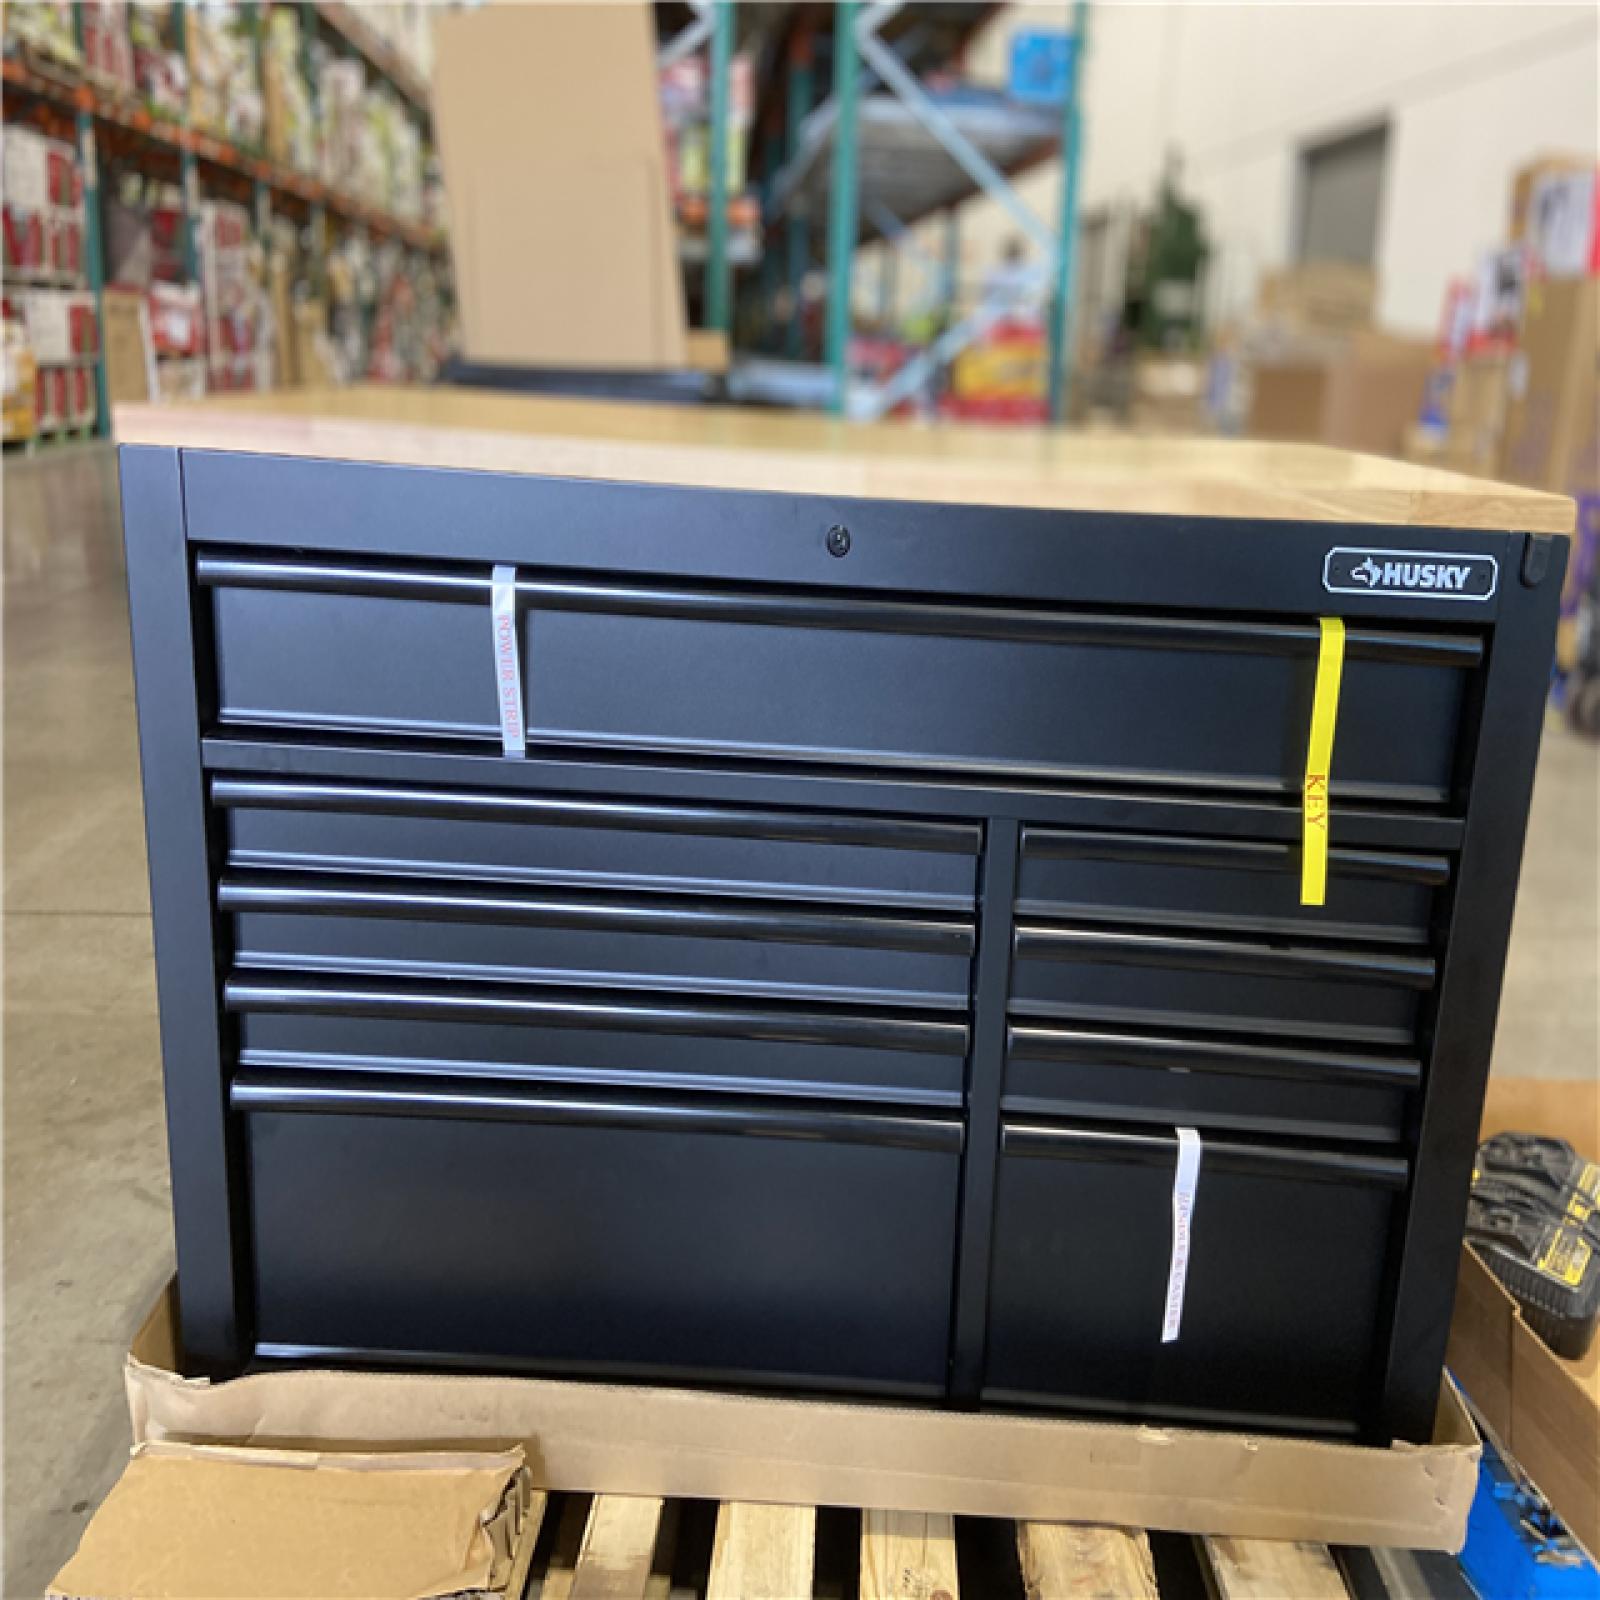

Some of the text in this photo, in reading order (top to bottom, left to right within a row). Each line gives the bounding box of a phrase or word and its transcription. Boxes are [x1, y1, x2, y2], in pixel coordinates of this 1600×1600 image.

[1382, 562, 1471, 590] HUSKY
[497, 614, 520, 738] POWER STRIP
[1306, 774, 1326, 830] KEY
